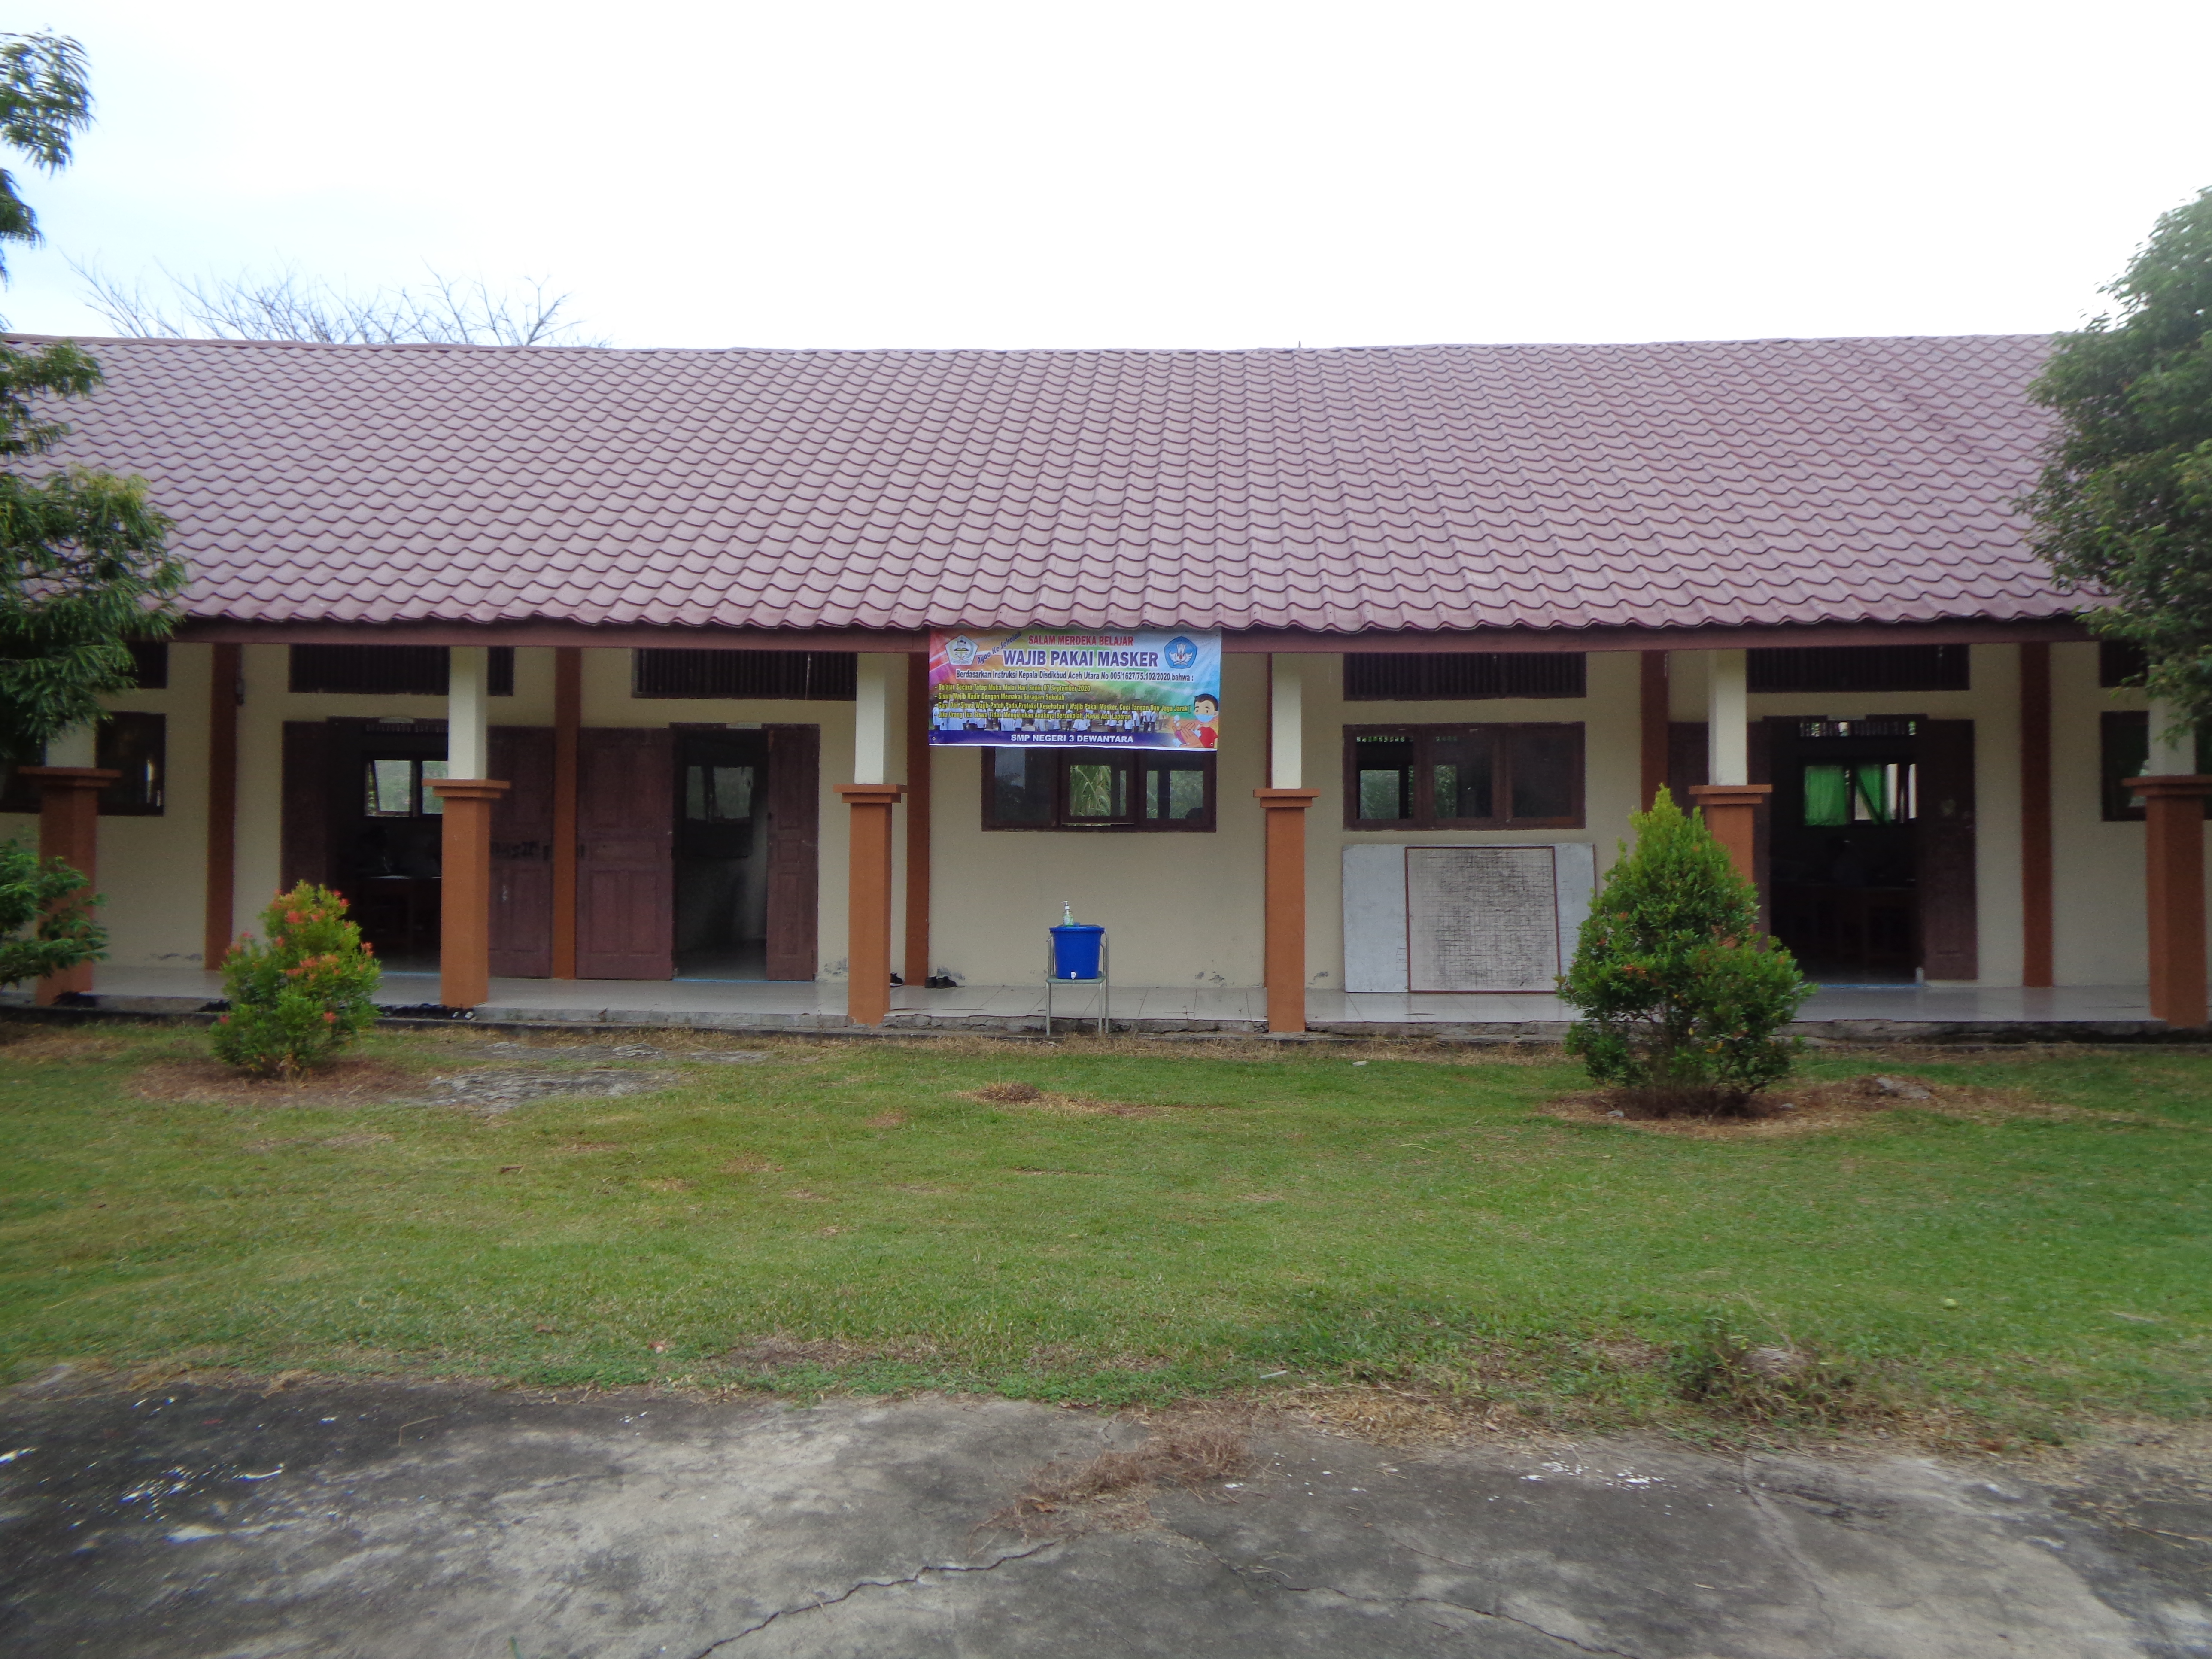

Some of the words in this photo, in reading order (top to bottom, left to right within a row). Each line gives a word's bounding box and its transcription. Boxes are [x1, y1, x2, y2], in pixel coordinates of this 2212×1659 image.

[1028, 635, 1056, 645] SALAM
[1057, 635, 1097, 646] MERDEKA
[1099, 635, 1134, 646] BELAJAR
[977, 651, 991, 665] Ayoo
[992, 646, 1000, 656] Ke
[1000, 631, 1022, 649] Sekolah
[1003, 650, 1046, 665] WAJIB
[1050, 650, 1094, 666] PAKAI
[1097, 651, 1159, 667] MASKER
[956, 670, 991, 678] Berdasarkan
[993, 670, 1017, 678] Instruksi
[1018, 670, 1038, 681] Kepala
[1039, 671, 1066, 679] Disdikbud
[1068, 671, 1082, 679] Aceh
[1084, 671, 1099, 680] Utara
[1101, 672, 1109, 680] No
[1172, 673, 1191, 681] bahwa
[975, 702, 989, 710] Wajib
[948, 711, 963, 719] Orang
[1032, 734, 1066, 742] NEGERI
[1076, 735, 1134, 743] DEWANTARA
